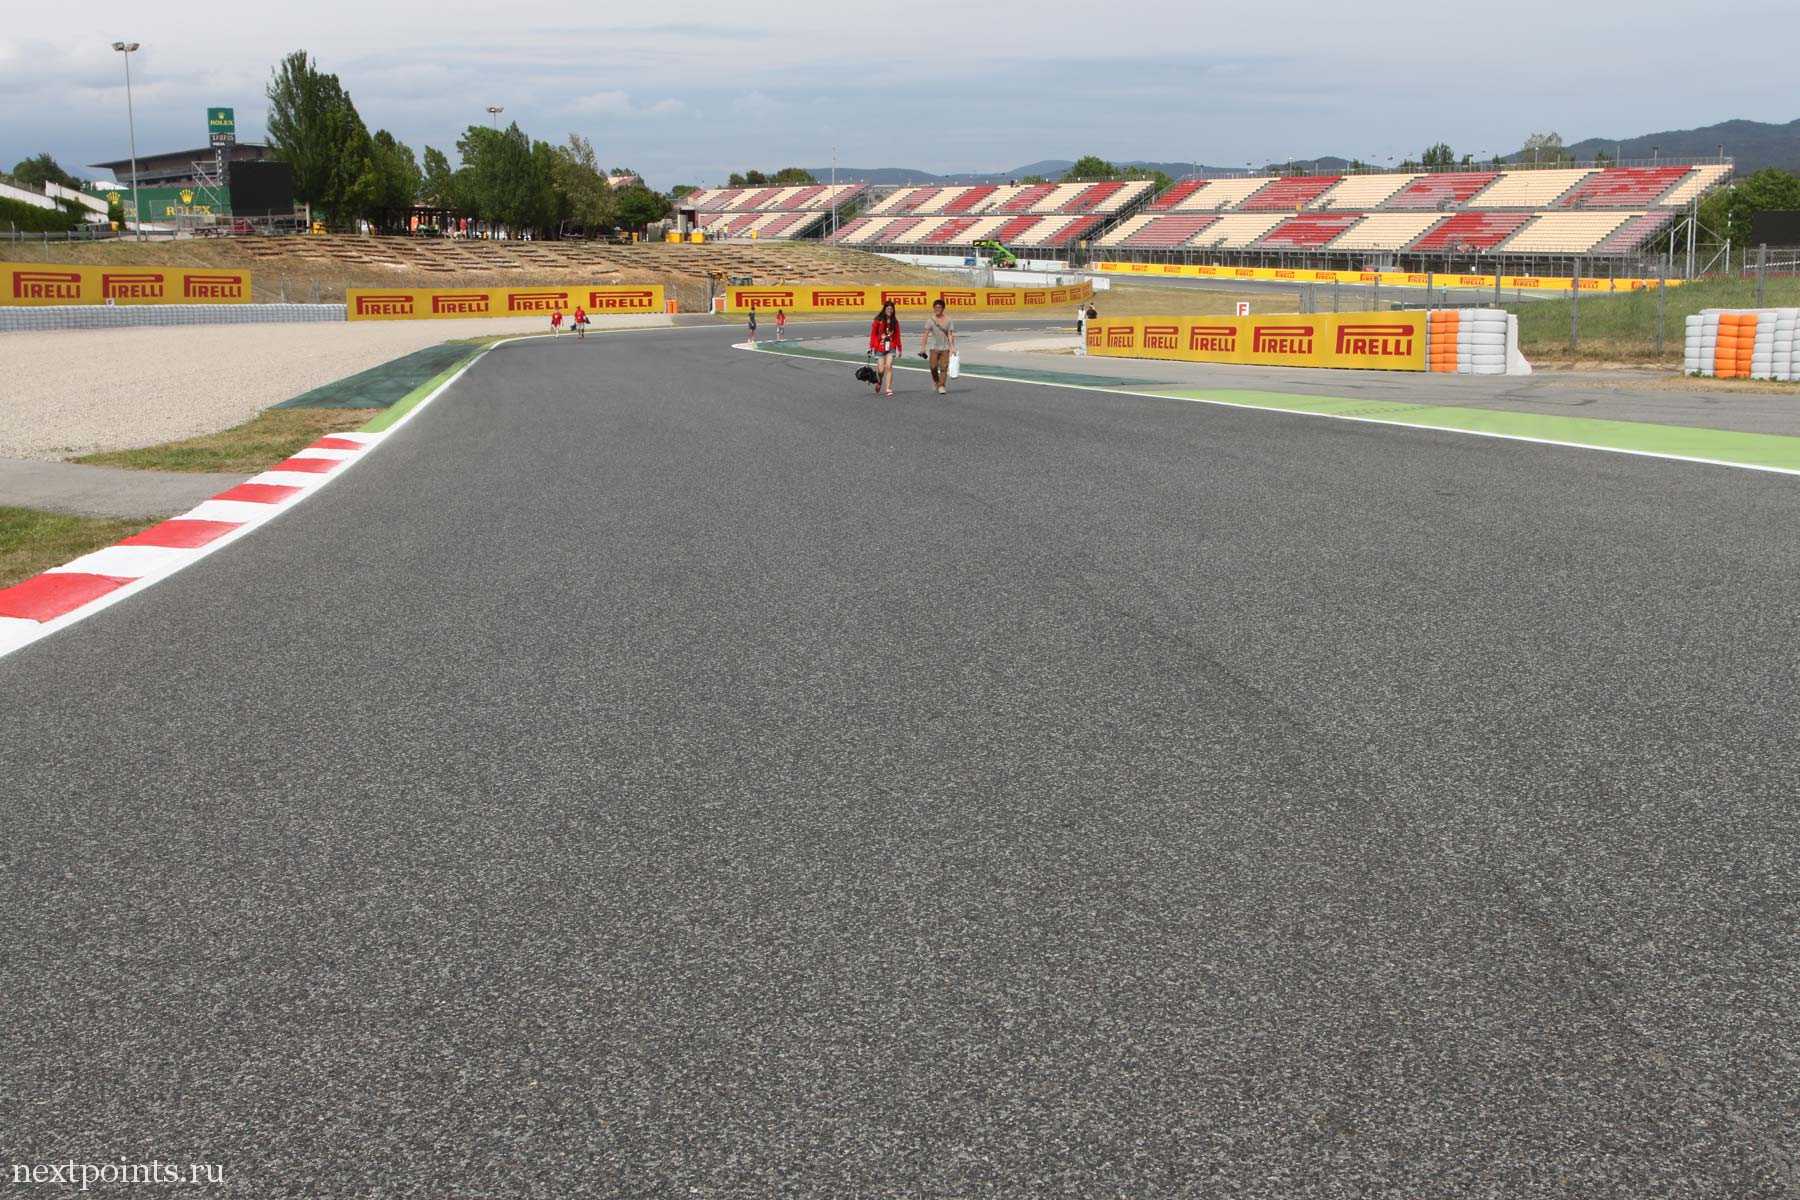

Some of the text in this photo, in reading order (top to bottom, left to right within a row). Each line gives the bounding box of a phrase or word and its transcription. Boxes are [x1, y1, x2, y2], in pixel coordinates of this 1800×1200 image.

[13, 272, 242, 299] PIRELLI PIRELLI PIRELLI
[356, 291, 653, 315] PIRELLI PIRELLI PIRELLI PIRELLI
[735, 291, 794, 307] PIRELLI
[812, 291, 865, 306] PIRELLI
[880, 291, 927, 305] PIRELLI
[940, 291, 976, 306] PIRELLI
[986, 292, 1016, 306] PIRELLI
[1023, 292, 1046, 305] PIRELLI
[1239, 304, 1247, 316] F
[1107, 326, 1134, 348] PIRELLI
[1144, 326, 1179, 349] PIRELLI
[1189, 326, 1237, 352] PIRELLI
[1253, 326, 1314, 354] PIRELLI
[1335, 324, 1415, 356] PIRELLI
